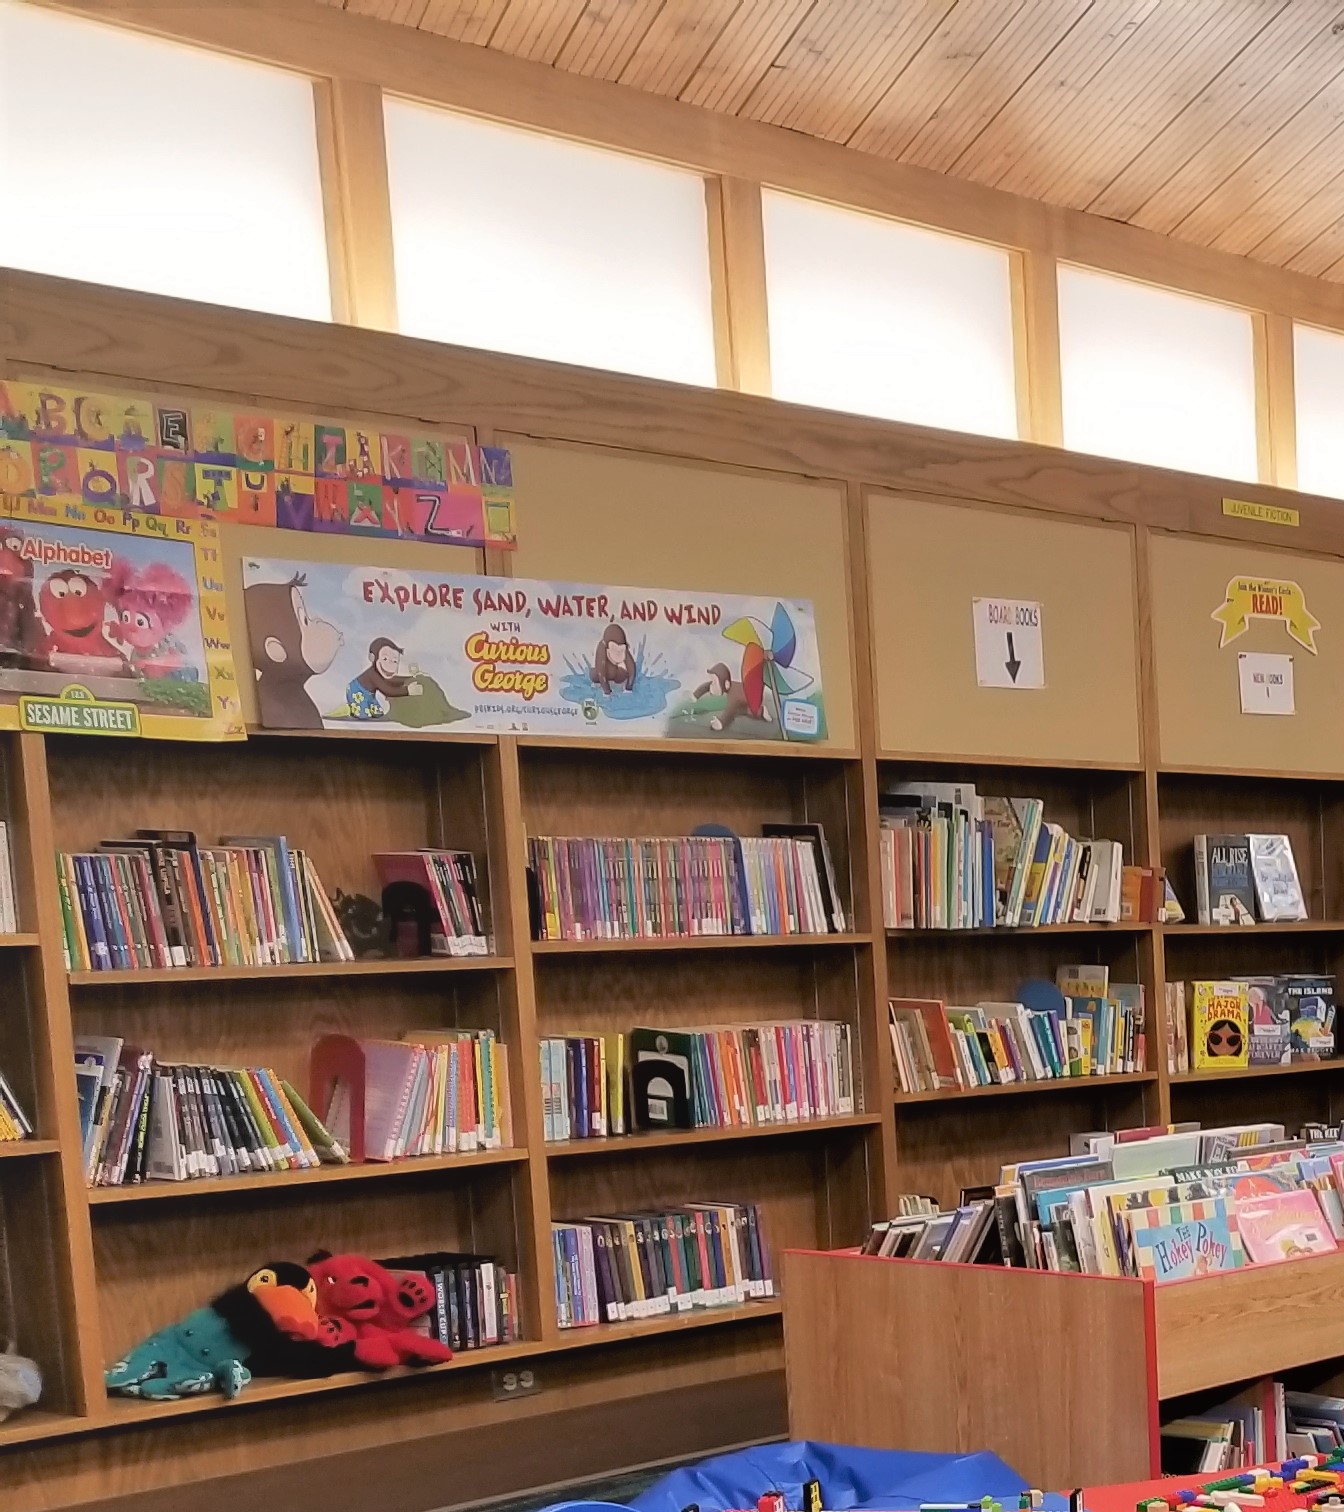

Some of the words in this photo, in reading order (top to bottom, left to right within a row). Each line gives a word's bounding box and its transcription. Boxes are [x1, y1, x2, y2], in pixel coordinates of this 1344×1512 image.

[122, 511, 140, 533] Pp
[145, 516, 169, 537] Qq
[22, 539, 112, 568] Alphabet
[362, 578, 465, 612] EXPLORE
[473, 588, 531, 618] SAND,
[538, 594, 616, 623] WATER,
[620, 600, 658, 622] AND
[664, 603, 721, 626] WIND
[1252, 593, 1283, 616] READ!
[490, 622, 521, 633] WITH
[1015, 606, 1039, 627] BOOKS
[465, 630, 550, 665] Curious
[473, 662, 550, 701] George
[27, 703, 80, 727] SESAME
[83, 707, 133, 730] STREET
[1304, 986, 1333, 995] ISLAND
[1207, 1008, 1242, 1021] DRAMA
[1208, 998, 1241, 1011] MAJOR
[1175, 1170, 1202, 1184] MAKE
[1175, 1225, 1192, 1243] THE
[1155, 1237, 1195, 1274] Hokey
[1195, 1222, 1228, 1268] Pokey
